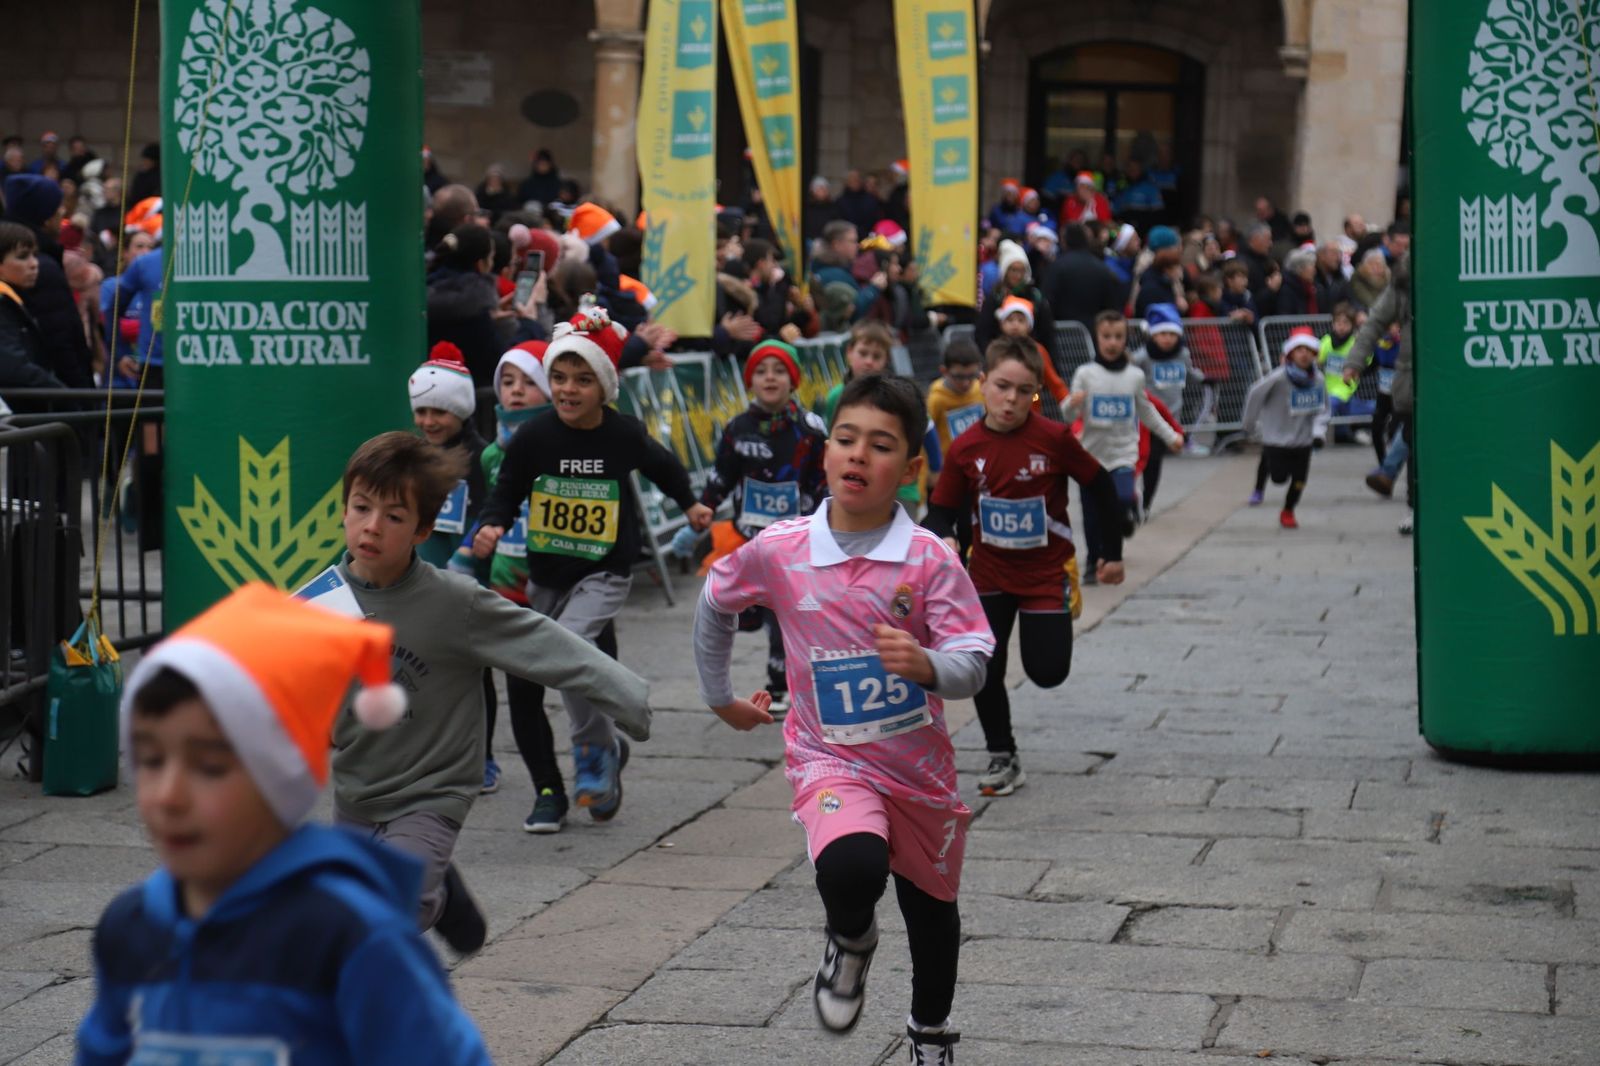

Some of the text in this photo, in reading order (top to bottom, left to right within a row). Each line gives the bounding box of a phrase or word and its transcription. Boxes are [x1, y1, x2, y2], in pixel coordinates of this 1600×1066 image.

[176, 301, 370, 331] FUNDACION
[1463, 297, 1600, 332] FUNDA
[176, 334, 371, 367] CAJA RURAL
[1463, 334, 1554, 369] CAJA
[560, 459, 604, 474] FREE
[540, 499, 607, 536] 1883
[753, 493, 789, 513] 126
[990, 511, 1034, 532] 054
[389, 643, 430, 678] OMPANY
[834, 673, 909, 714] 125
